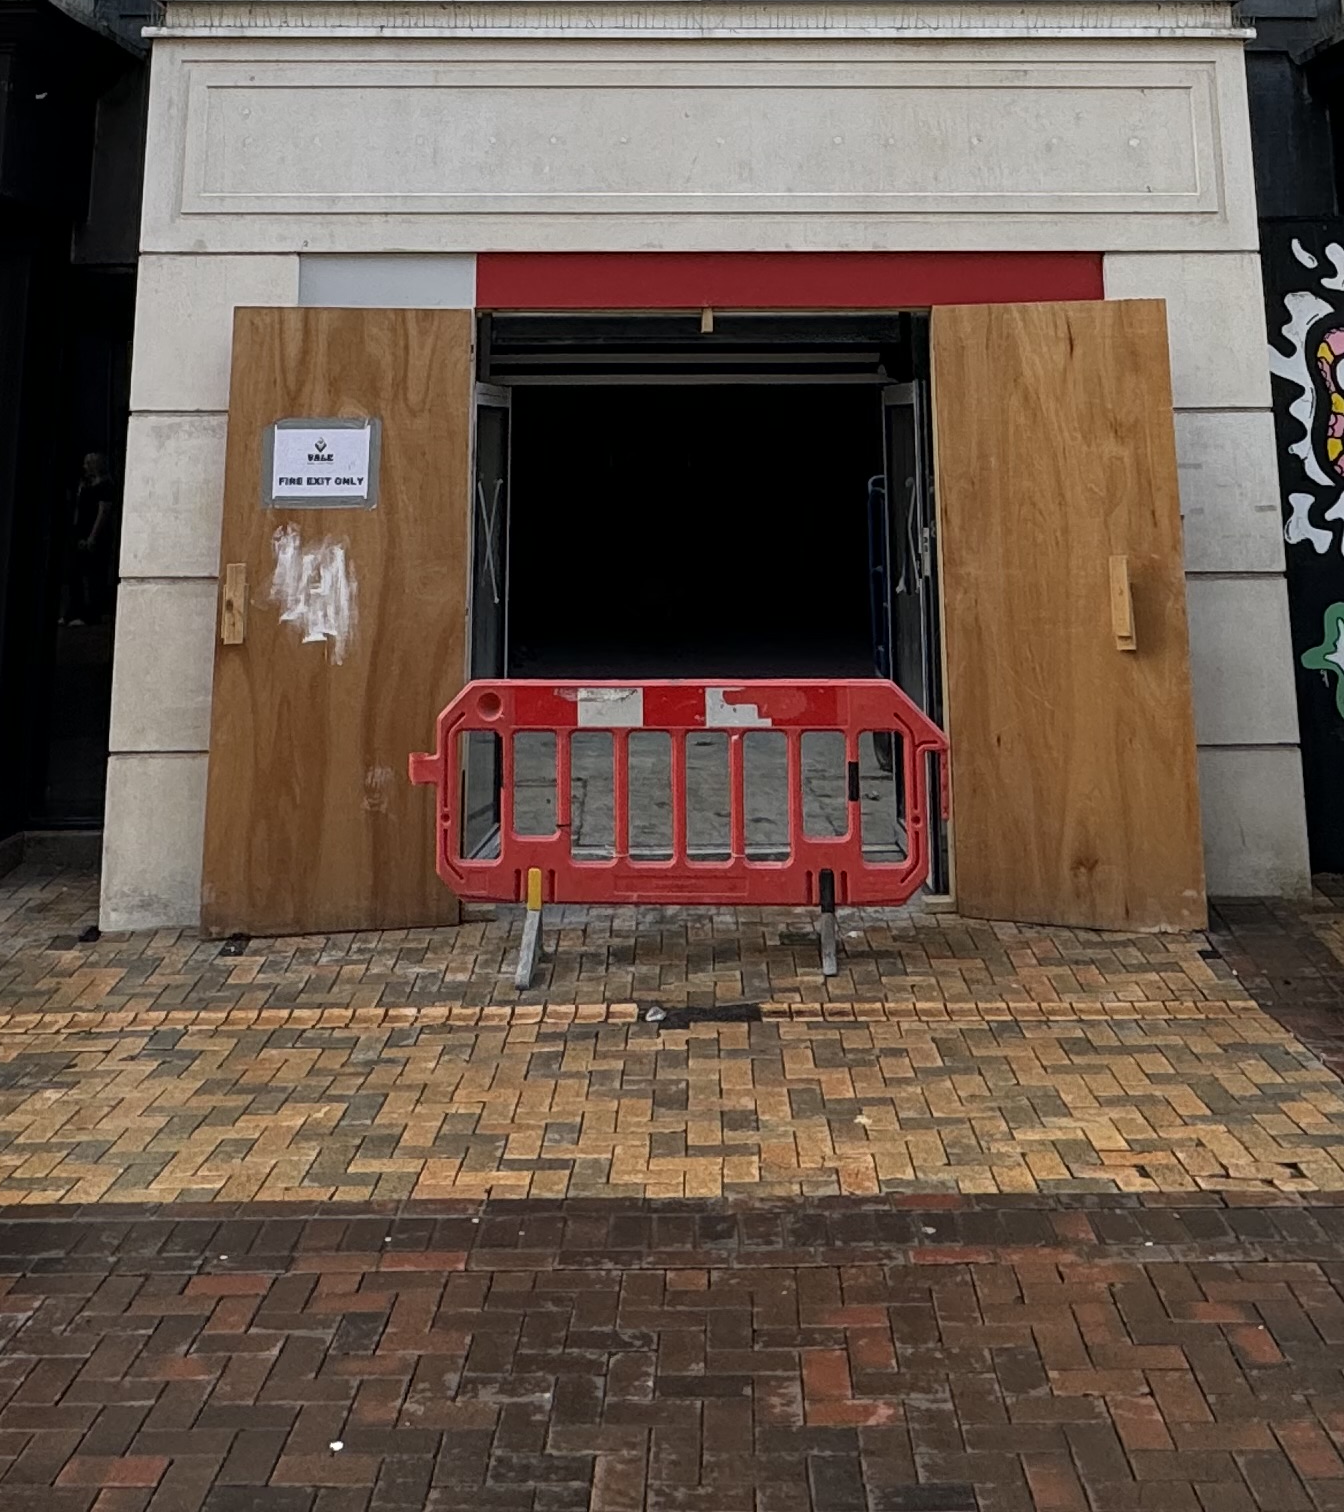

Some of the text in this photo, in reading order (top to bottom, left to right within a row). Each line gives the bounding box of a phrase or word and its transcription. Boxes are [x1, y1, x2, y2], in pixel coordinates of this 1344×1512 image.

[278, 476, 364, 486] FIRE EXIT ONLY
